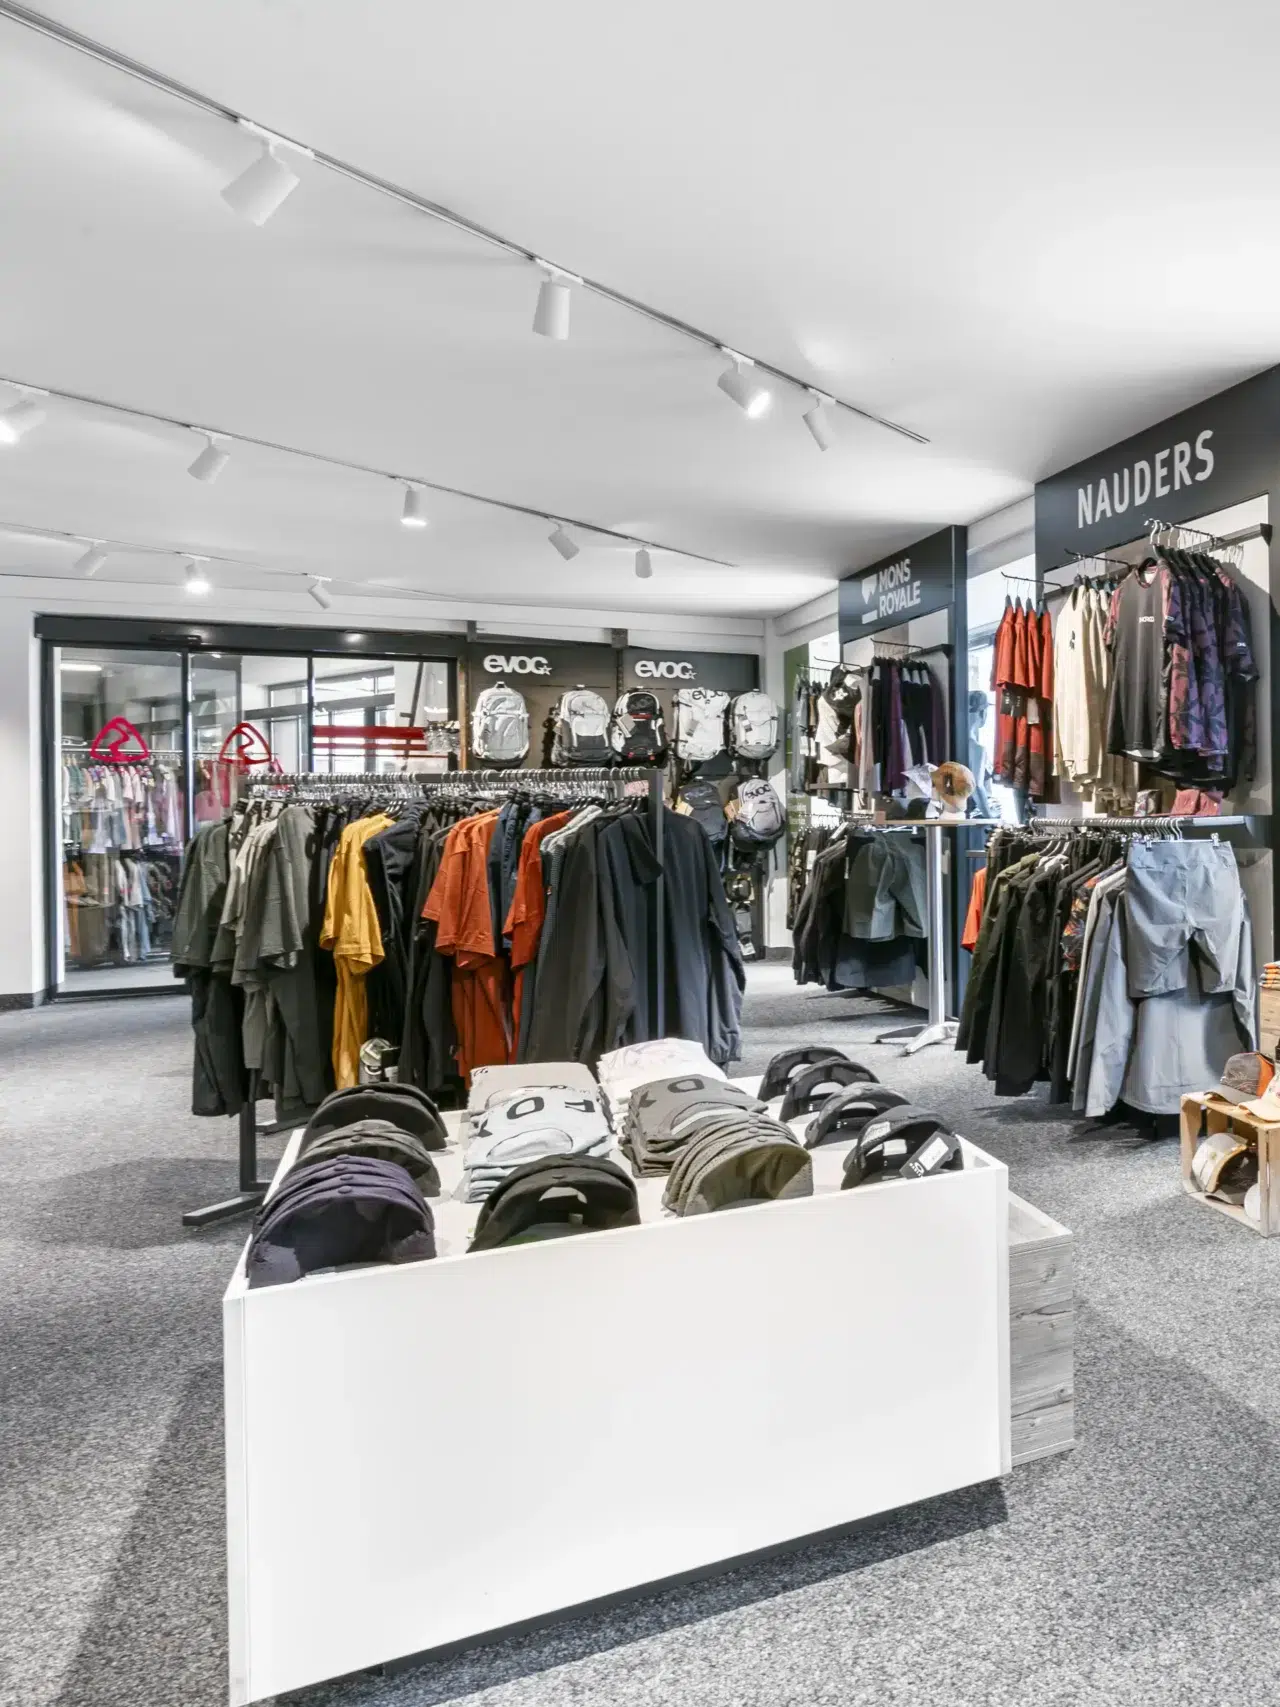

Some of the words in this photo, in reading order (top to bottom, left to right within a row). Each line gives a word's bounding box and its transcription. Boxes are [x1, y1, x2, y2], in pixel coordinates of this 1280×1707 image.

[1078, 430, 1214, 528] NAUDERS
[879, 558, 911, 592] MONS
[879, 580, 921, 618] ROYALE
